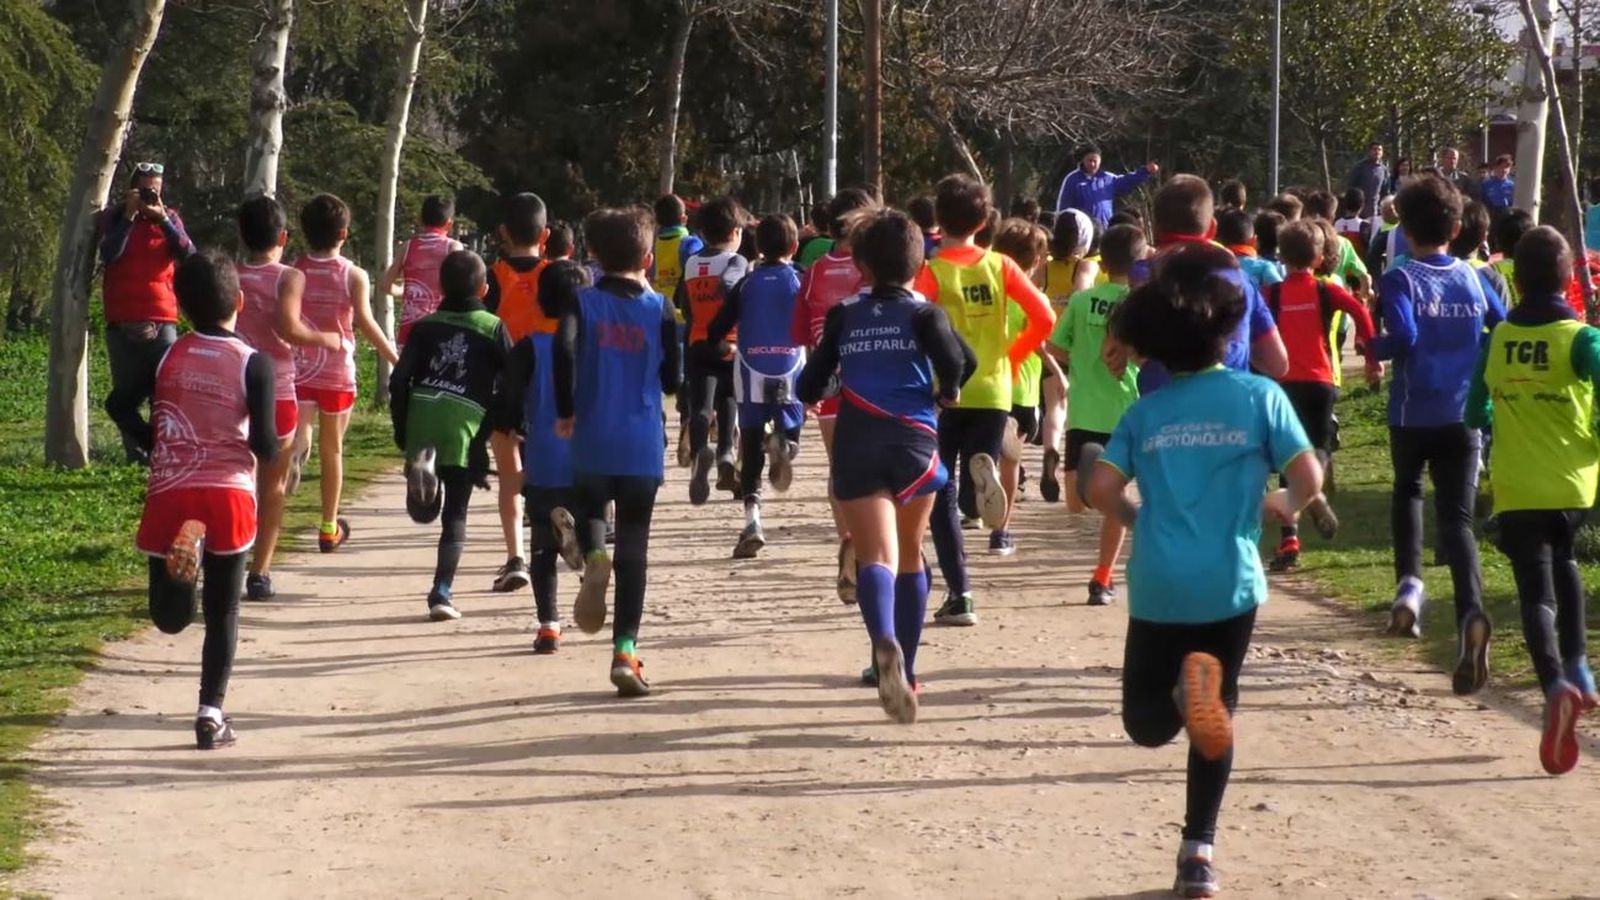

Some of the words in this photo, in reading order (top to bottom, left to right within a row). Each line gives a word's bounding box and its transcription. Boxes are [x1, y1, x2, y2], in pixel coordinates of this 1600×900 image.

[962, 284, 992, 304] TCR
[849, 326, 901, 338] ATLETISMO
[874, 339, 917, 351] PARLA
[1504, 340, 1549, 365] TCR
